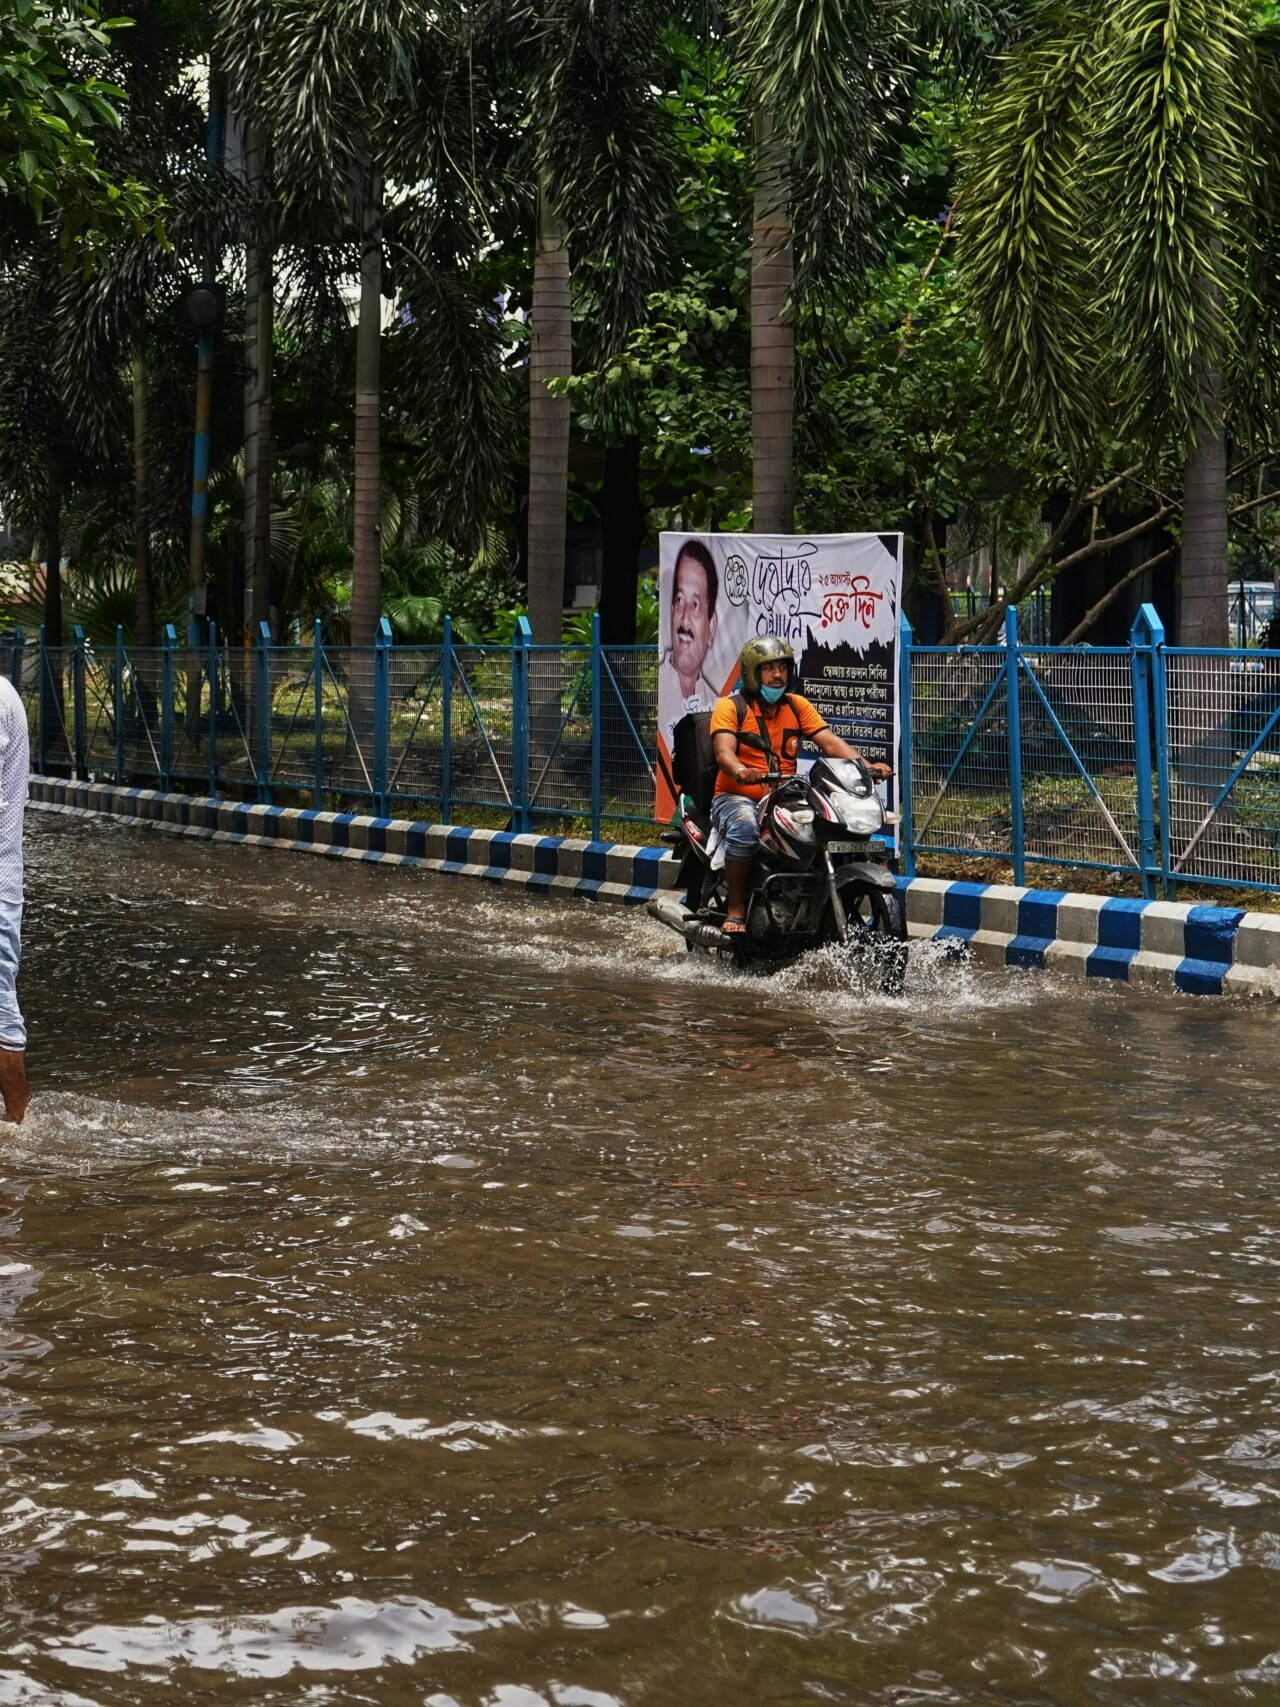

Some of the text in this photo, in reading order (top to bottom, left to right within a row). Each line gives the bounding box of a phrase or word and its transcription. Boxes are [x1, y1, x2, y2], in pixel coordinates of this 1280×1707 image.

[849, 575, 884, 630] দিন
[846, 667, 868, 679] রক্তদান
[869, 664, 887, 679] শিবির
[867, 684, 887, 700] পরীক্ষা
[852, 722, 873, 737] বিতরণ
[874, 728, 887, 739] এবং
[870, 746, 887, 758] প্রদান
